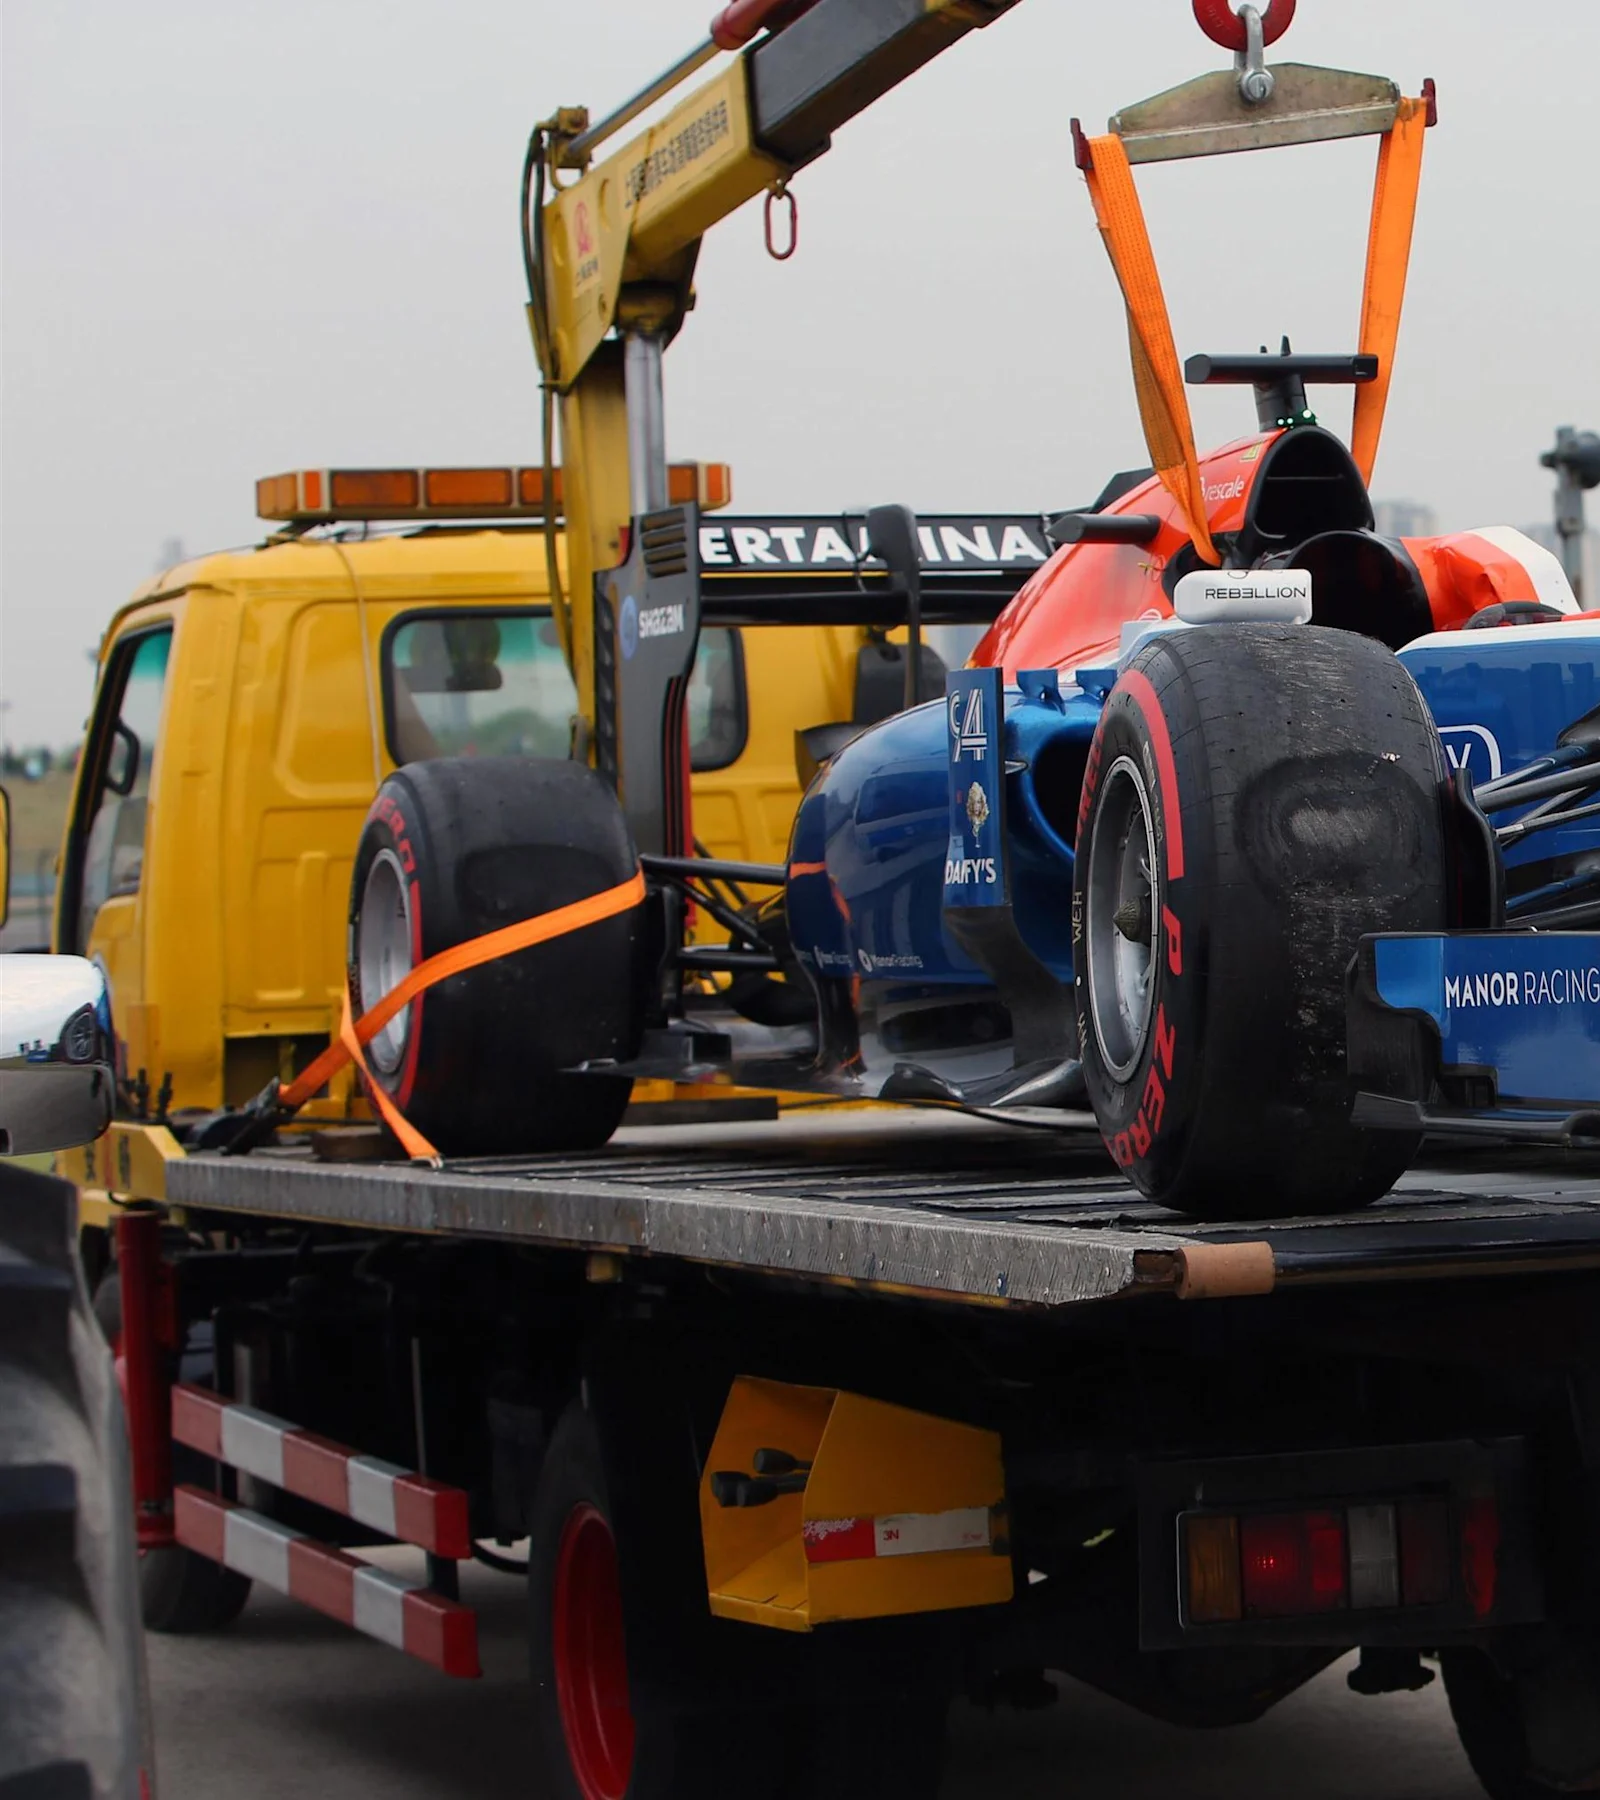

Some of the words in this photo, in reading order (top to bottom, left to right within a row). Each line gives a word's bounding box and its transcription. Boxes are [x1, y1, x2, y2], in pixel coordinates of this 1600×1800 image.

[1204, 475, 1245, 500] rescale
[1163, 904, 1184, 976] P
[1445, 971, 1520, 1009] MANOR
[1523, 967, 1600, 1006] RACING
[1103, 1003, 1176, 1168] ZERO
